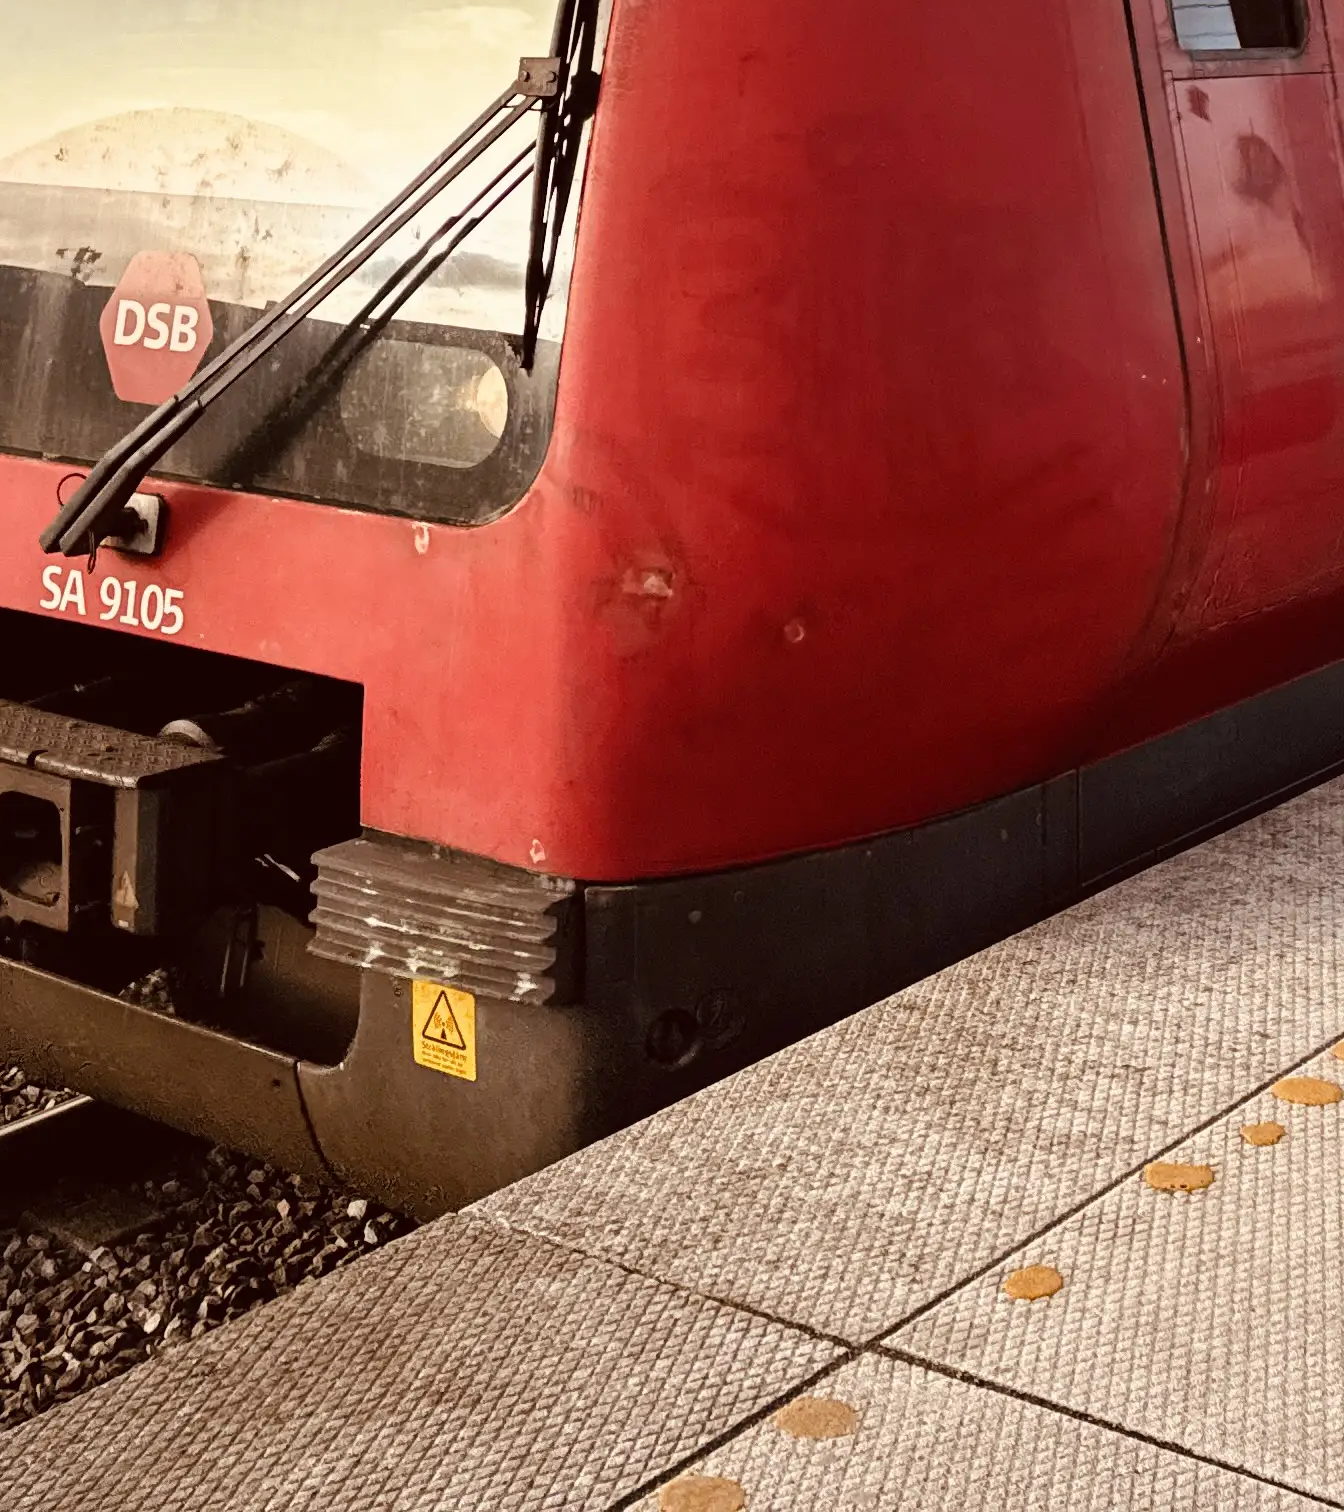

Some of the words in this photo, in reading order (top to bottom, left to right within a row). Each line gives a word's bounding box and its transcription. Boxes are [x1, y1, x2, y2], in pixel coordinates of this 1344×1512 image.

[113, 299, 199, 353] DSB
[39, 566, 86, 616] SA
[99, 576, 185, 635] 9105
